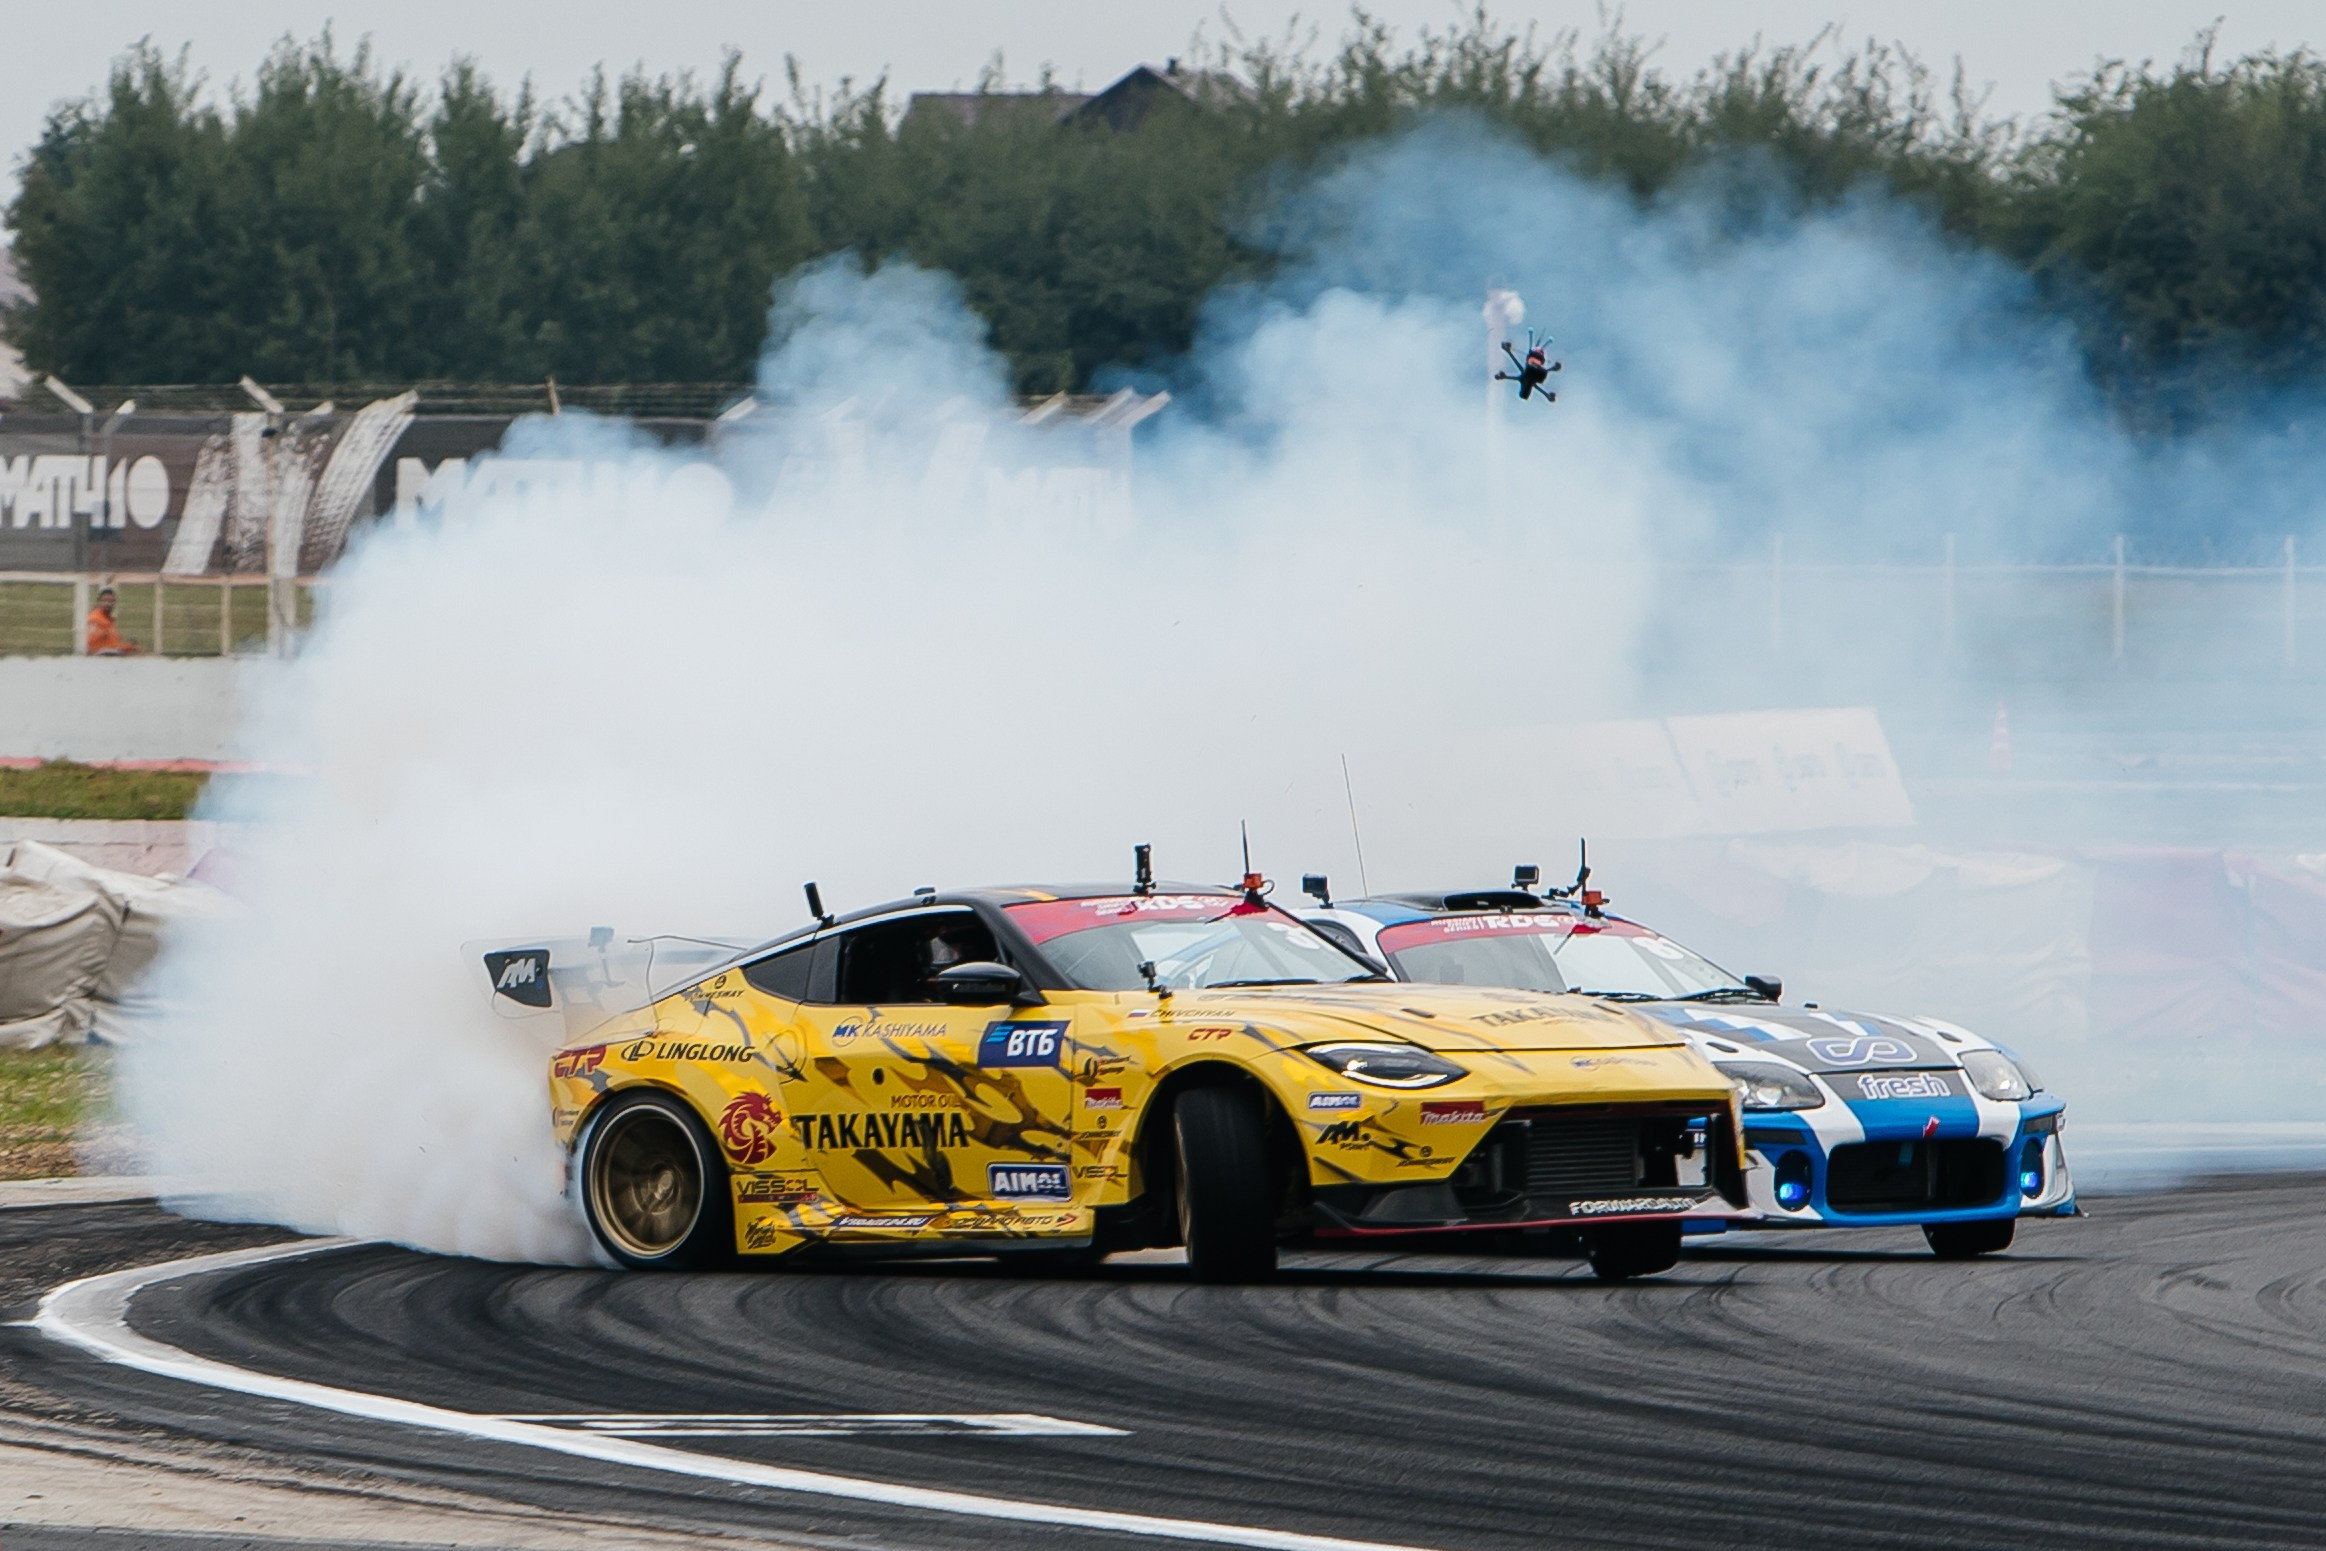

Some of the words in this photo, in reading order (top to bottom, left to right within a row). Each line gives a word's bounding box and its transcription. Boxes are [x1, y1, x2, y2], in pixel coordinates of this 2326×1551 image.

[1483, 914, 1560, 930] RDS
[862, 1023, 948, 1038] KASHIYAMA
[656, 1042, 756, 1063] LINGLONG
[1006, 1029, 1059, 1057] ВТБ
[1857, 1072, 1951, 1100] fresh
[890, 1094, 937, 1109] MOTOR
[798, 1112, 970, 1150] TAKAYAMA
